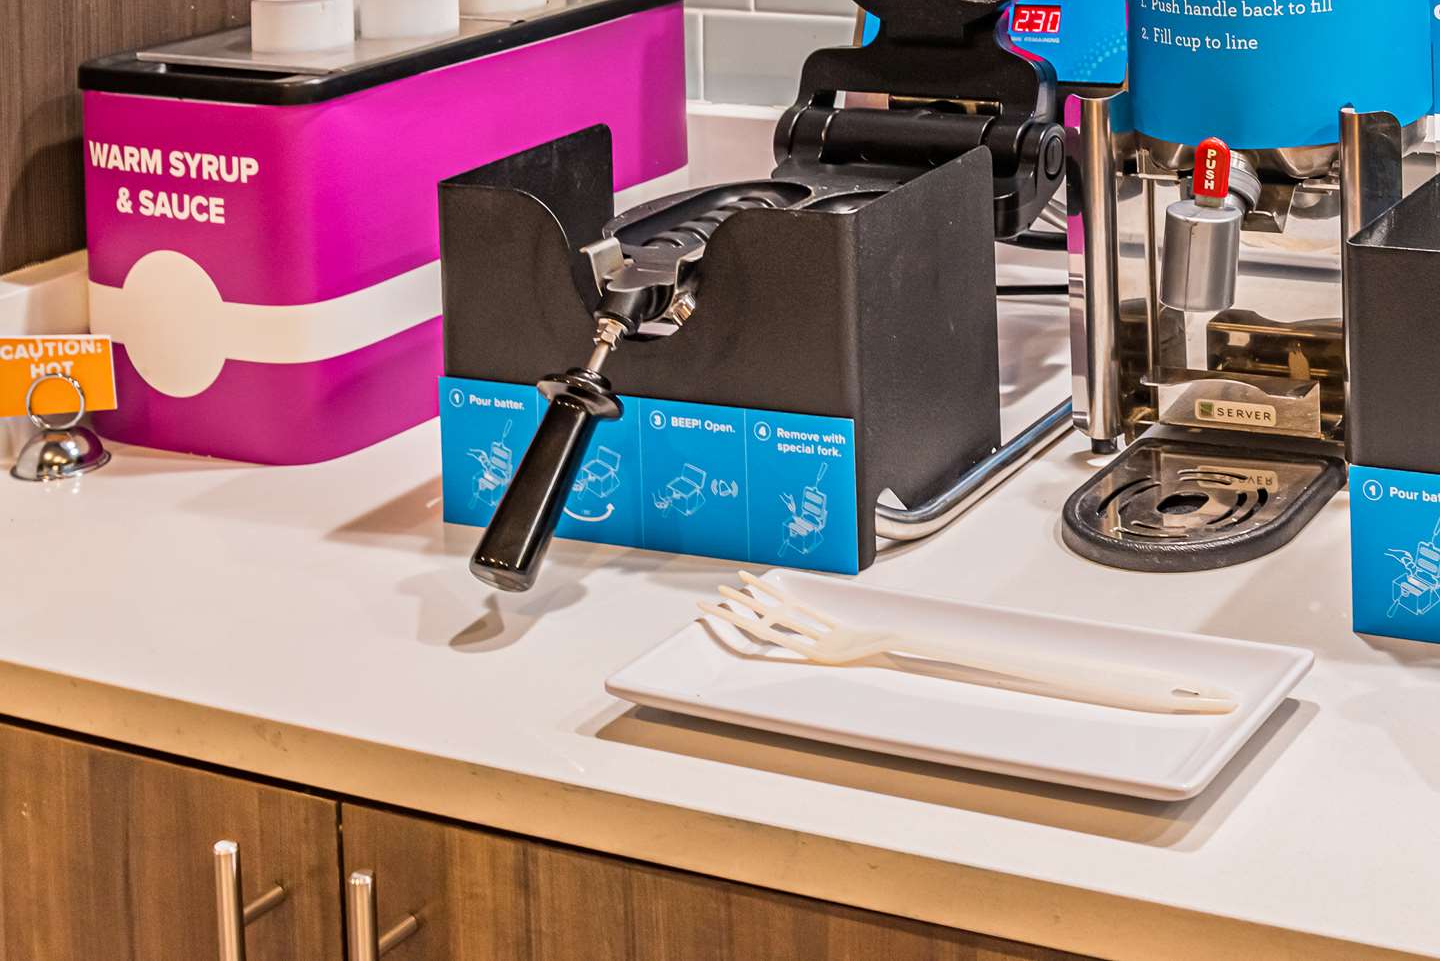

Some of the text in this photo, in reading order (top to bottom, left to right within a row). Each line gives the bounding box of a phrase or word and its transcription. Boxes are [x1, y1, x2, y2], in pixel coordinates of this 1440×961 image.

[1241, 0, 1284, 17] back
[1288, 1, 1306, 15] to
[1153, 27, 1172, 45] Fill
[1175, 33, 1201, 51] cup
[1205, 35, 1221, 50] to
[1225, 33, 1258, 50] line
[88, 140, 260, 184] WARM SYRUP
[1204, 148, 1217, 190] PUSH
[116, 186, 225, 224] & SAUCE
[30, 360, 74, 379] HOT
[469, 394, 492, 406] Pour
[494, 398, 525, 410] batter.
[1217, 407, 1272, 421] SERVER
[671, 416, 702, 429] BEEP!
[704, 420, 736, 433] Open.
[777, 428, 820, 442] Remove
[822, 433, 846, 445] with
[777, 442, 842, 457] special fork.
[1389, 486, 1419, 501] Pour
